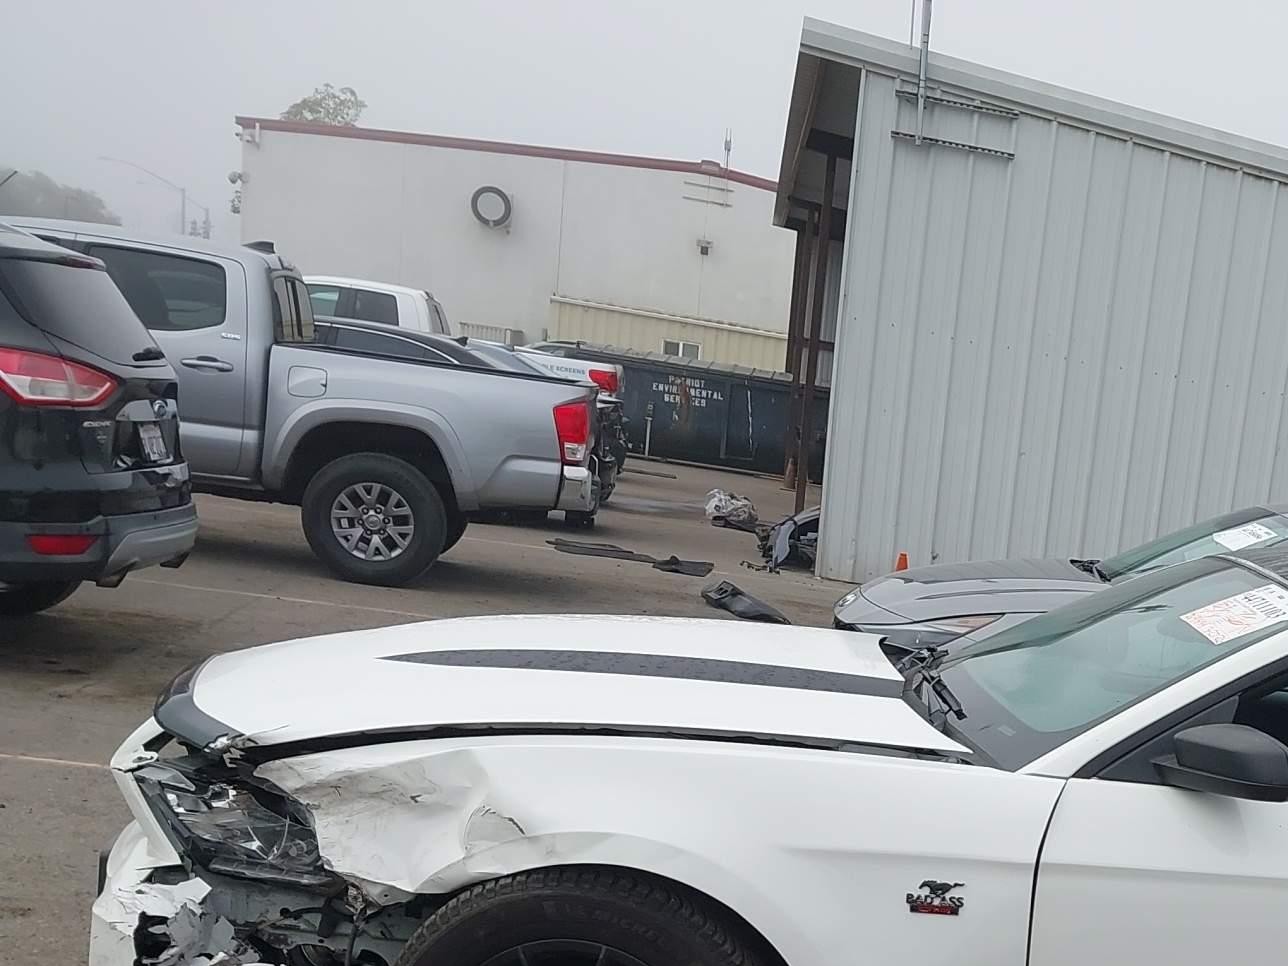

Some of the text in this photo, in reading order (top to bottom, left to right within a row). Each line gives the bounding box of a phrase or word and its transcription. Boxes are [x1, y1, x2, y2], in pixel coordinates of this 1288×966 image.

[556, 365, 585, 375] SCREENS
[664, 393, 706, 407] SERCES
[906, 893, 964, 908] BAD ASS
